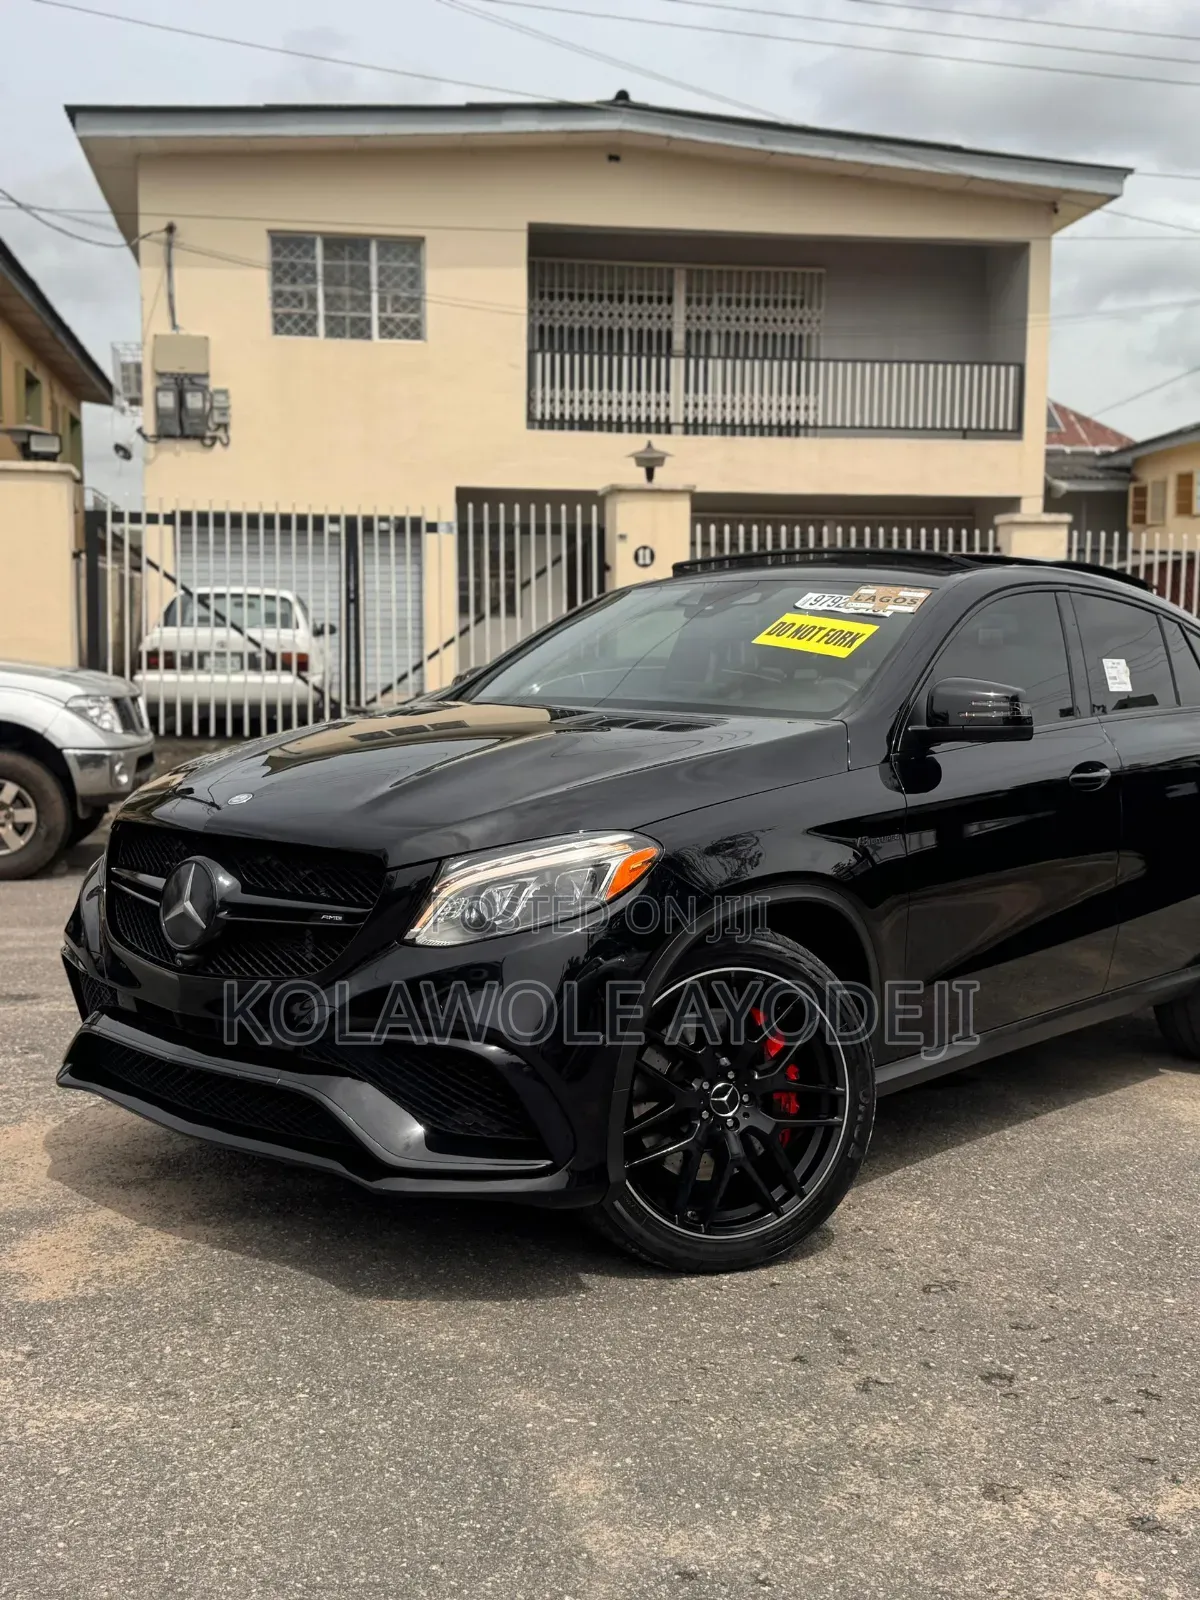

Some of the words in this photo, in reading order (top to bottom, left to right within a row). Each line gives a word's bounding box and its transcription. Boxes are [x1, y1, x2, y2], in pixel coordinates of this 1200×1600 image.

[854, 594, 920, 605] LAGOS
[765, 621, 796, 637] DO
[786, 623, 826, 641] NOT
[816, 628, 866, 649] FORK
